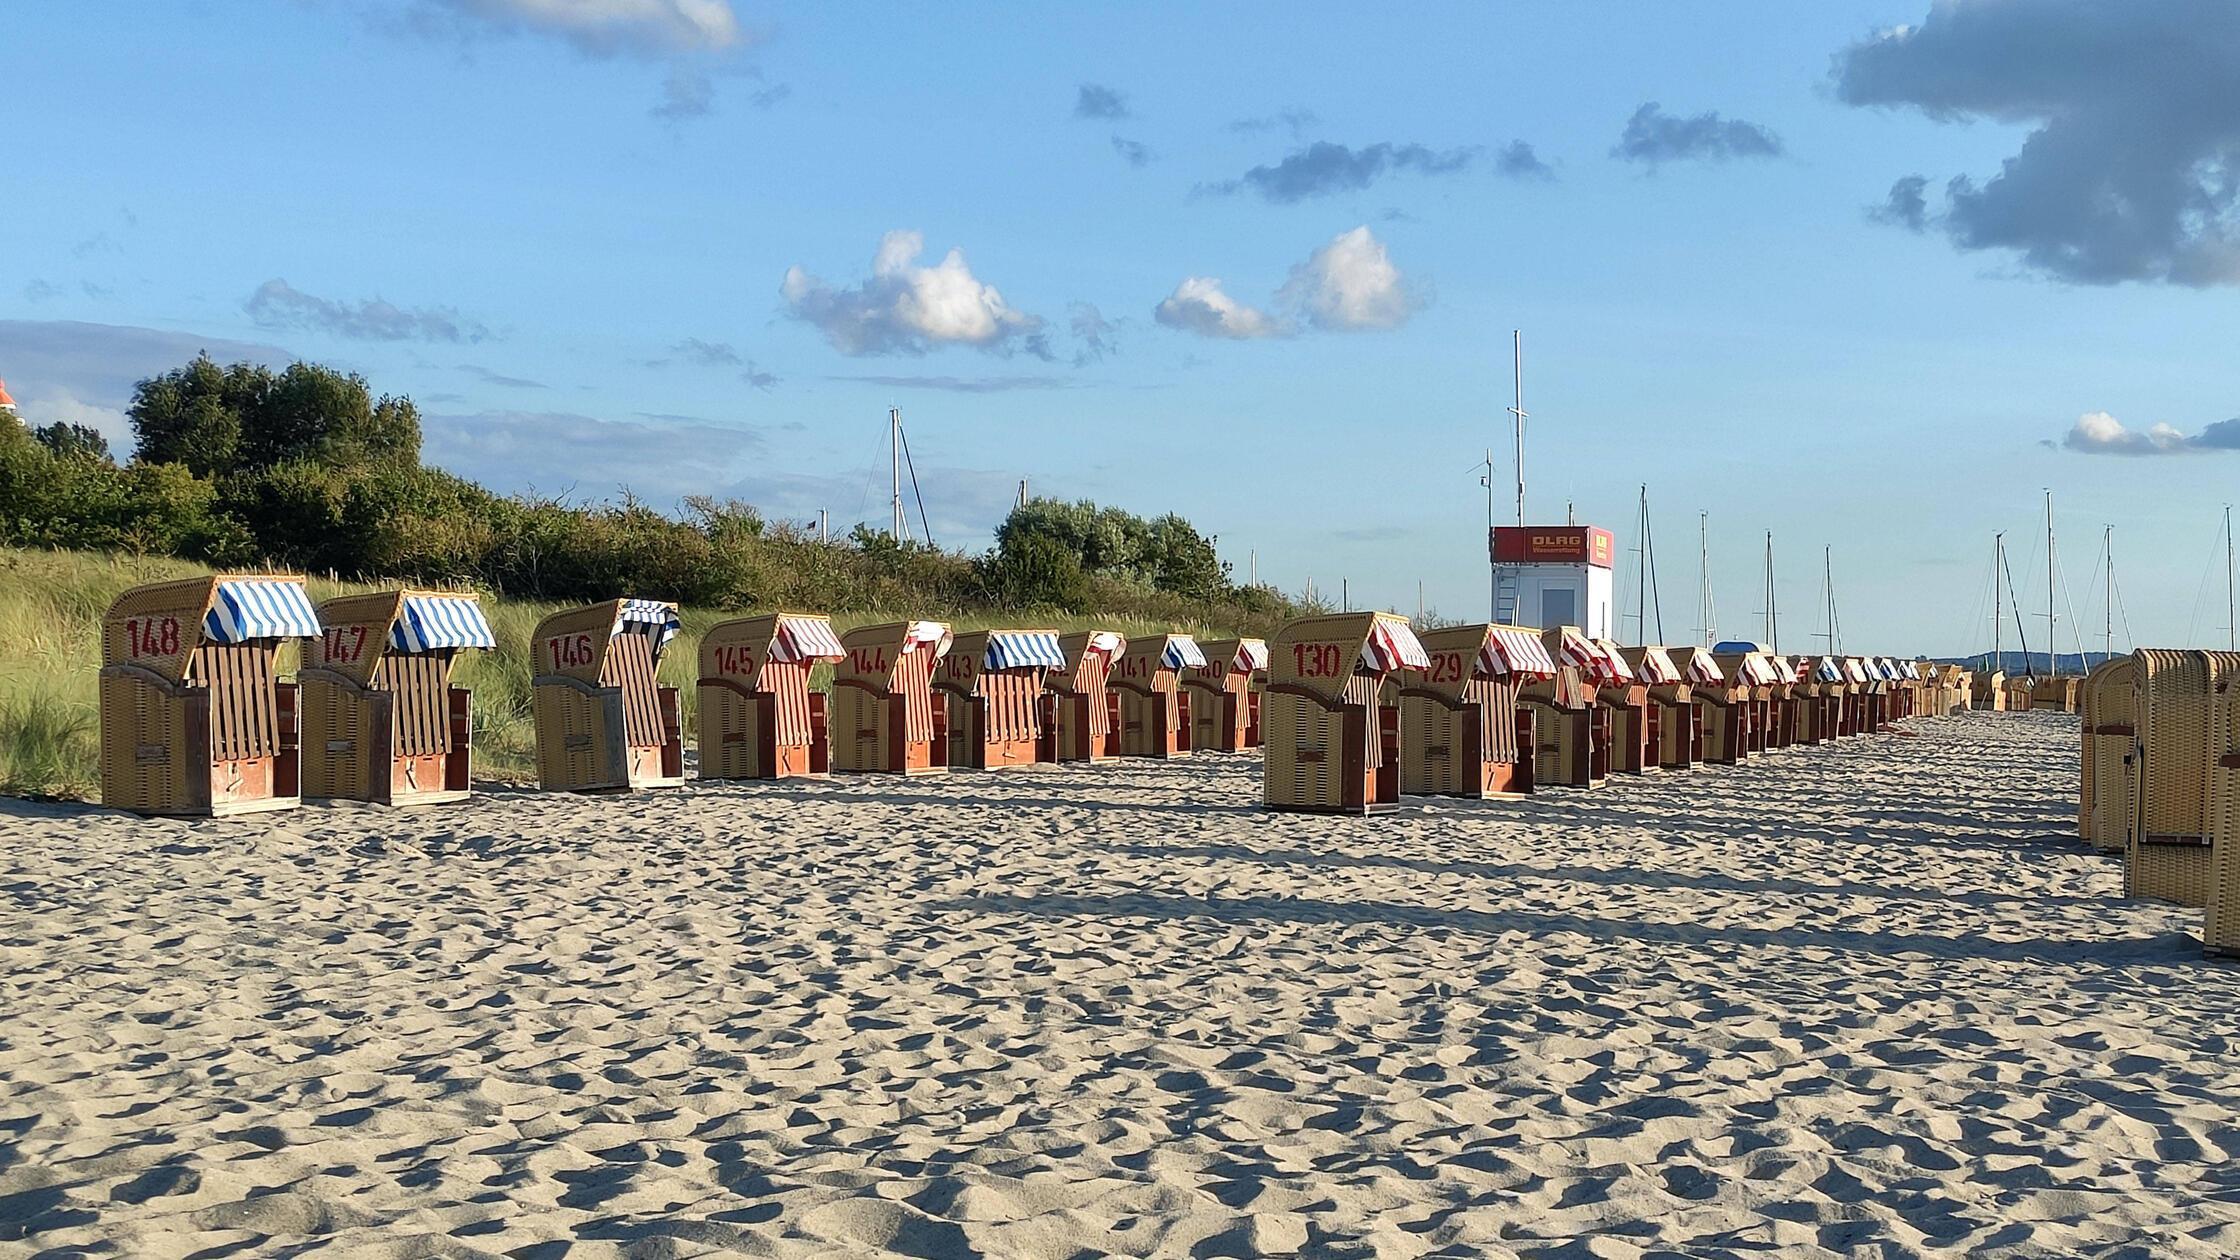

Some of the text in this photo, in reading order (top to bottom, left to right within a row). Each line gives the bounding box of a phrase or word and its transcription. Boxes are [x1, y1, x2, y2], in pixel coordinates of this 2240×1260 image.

[1532, 536, 1580, 545] DLRG
[127, 617, 180, 658] 148
[323, 626, 367, 663] 147
[549, 634, 593, 670] 146
[714, 646, 754, 675] 145
[850, 647, 887, 675] 144
[944, 654, 972, 680] 143
[1120, 656, 1147, 678] 141
[1293, 643, 1341, 678] 130
